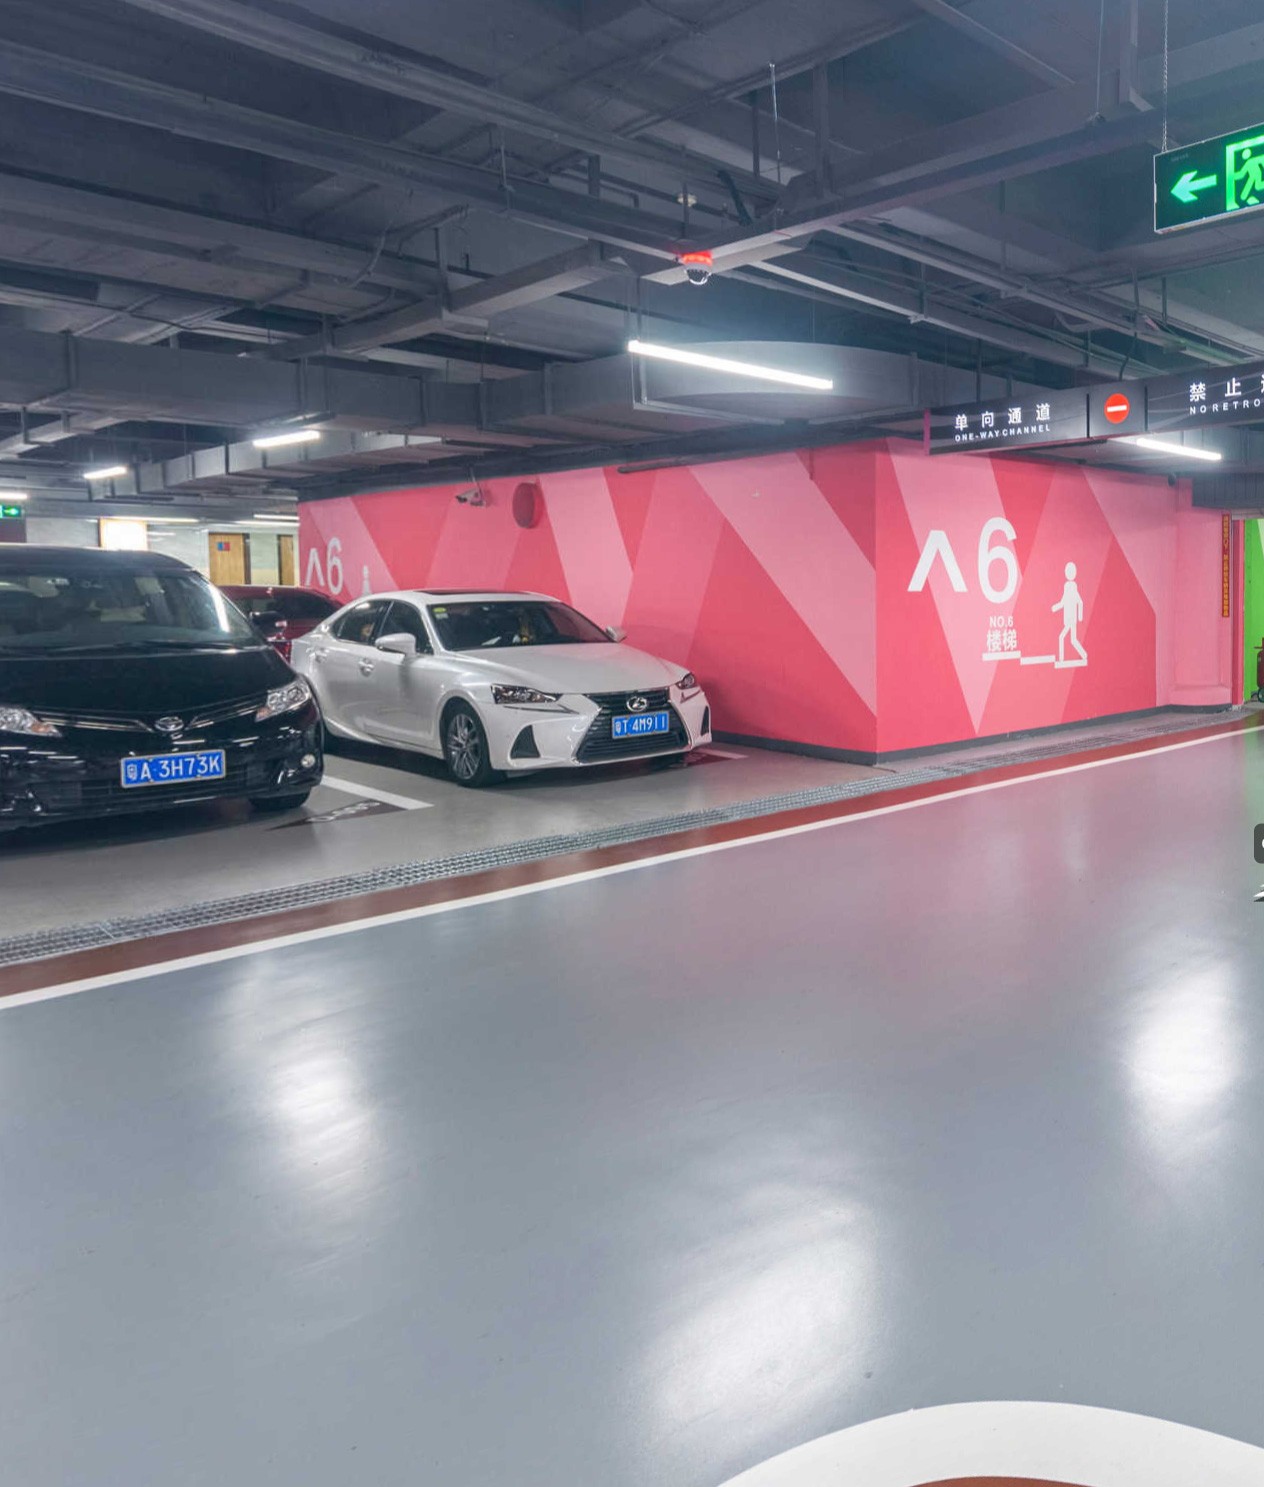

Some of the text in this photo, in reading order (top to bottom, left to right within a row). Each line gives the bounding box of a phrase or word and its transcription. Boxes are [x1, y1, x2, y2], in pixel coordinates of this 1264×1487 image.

[954, 403, 1051, 431] 单向通道
[989, 615, 1014, 629] NO.6
[986, 629, 1017, 652] 楼梯
